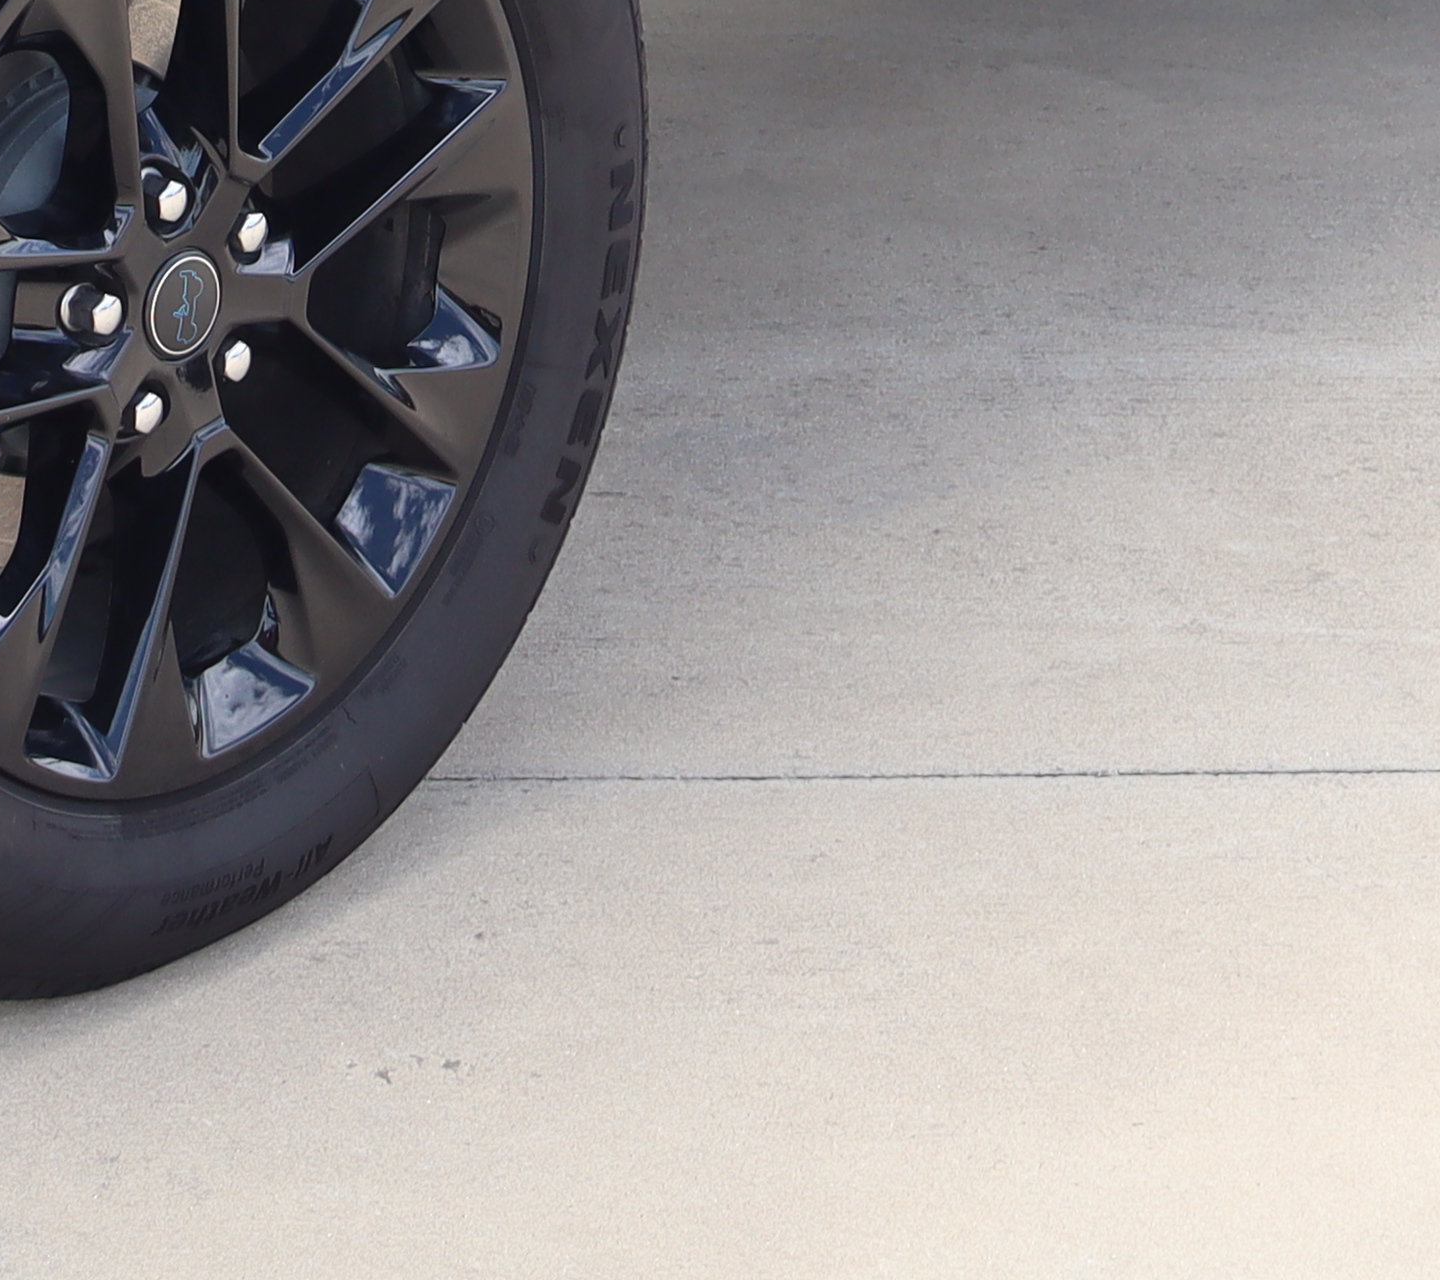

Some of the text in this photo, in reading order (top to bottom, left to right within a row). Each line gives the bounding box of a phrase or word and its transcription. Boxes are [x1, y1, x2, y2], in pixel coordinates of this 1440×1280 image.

[539, 157, 636, 528] NEXEN
[149, 833, 334, 937] All-Weather
[160, 858, 266, 907] Performance
